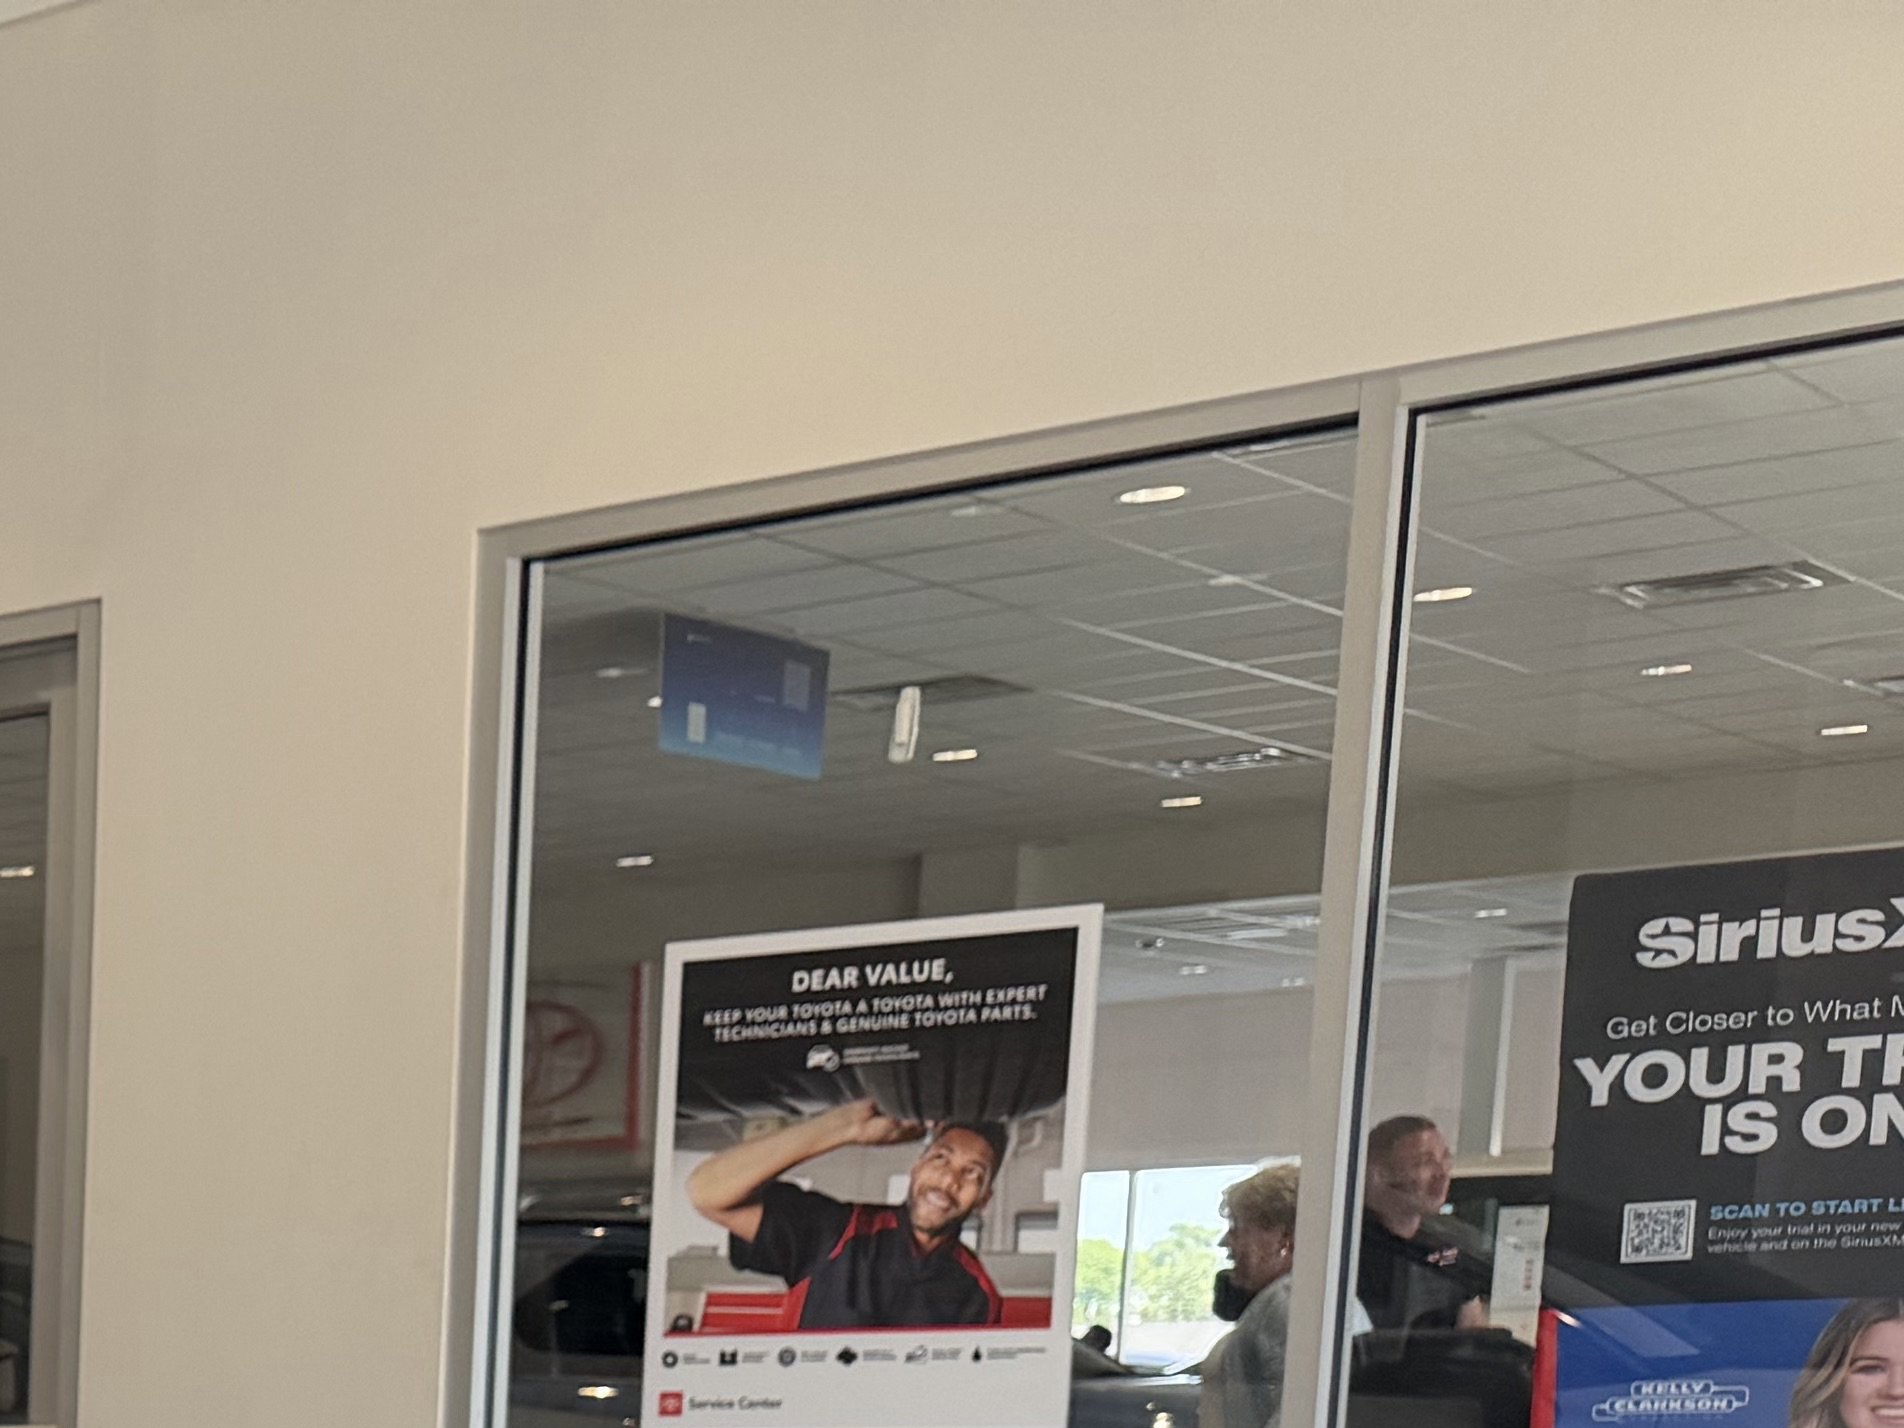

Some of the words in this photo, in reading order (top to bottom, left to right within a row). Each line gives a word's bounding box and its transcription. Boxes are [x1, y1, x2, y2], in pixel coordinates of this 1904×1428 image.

[792, 968, 859, 992] DEAR
[865, 957, 954, 987] VALUE,
[703, 1009, 741, 1027] KEEP
[745, 1005, 788, 1022] YOUR
[792, 1001, 852, 1020] TOYOTA
[856, 1001, 868, 1015] A
[872, 995, 934, 1014] TOYOTA
[938, 991, 981, 1008] WITH
[986, 984, 1047, 1005] EXPERT
[1607, 1014, 1658, 1041] Get
[1666, 1010, 1757, 1034] Closer
[1767, 1006, 1794, 1026] to
[1804, 997, 1882, 1025] What
[715, 1020, 817, 1042] TECHNICIANS
[836, 1014, 909, 1033] GENUINE
[914, 1009, 978, 1028] TOYOTA
[981, 1005, 1037, 1023] PARTS.
[1573, 1041, 1804, 1107] YOUR
[1700, 1100, 1778, 1156] IS
[1710, 1202, 1770, 1221] SCAN
[1776, 1201, 1806, 1217] TO
[1811, 1198, 1883, 1215] START
[1708, 1225, 1748, 1242] Enjoy
[1751, 1227, 1784, 1240] your
[1788, 1223, 1814, 1236] trial
[1818, 1223, 1831, 1234] in
[1835, 1223, 1867, 1236] your
[1871, 1221, 1901, 1232] new
[1760, 1238, 1788, 1251] and
[1791, 1239, 1810, 1250] on
[1813, 1236, 1837, 1249] the
[1614, 1398, 1728, 1413] CLARKSON
[1641, 1381, 1706, 1396] KELLY
